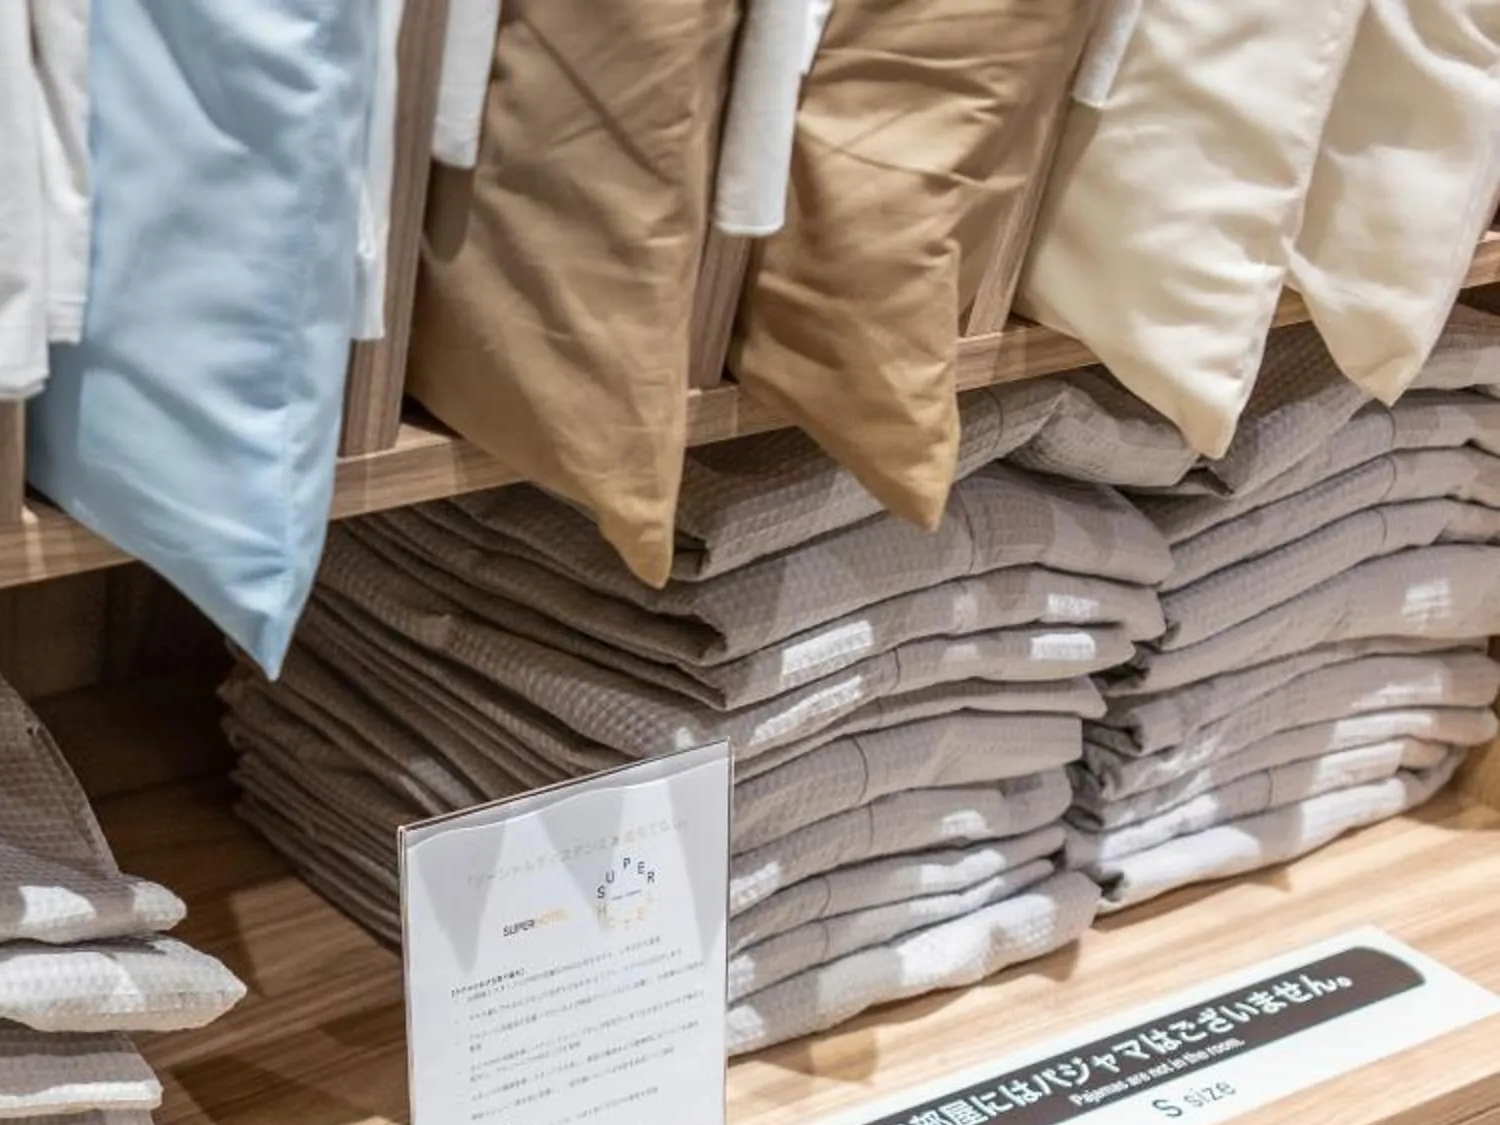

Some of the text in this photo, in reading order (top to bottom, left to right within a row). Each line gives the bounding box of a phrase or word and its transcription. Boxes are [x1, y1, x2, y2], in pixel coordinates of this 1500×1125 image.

[597, 857, 655, 899] SUPER
[1152, 1081, 1237, 1118] S size
